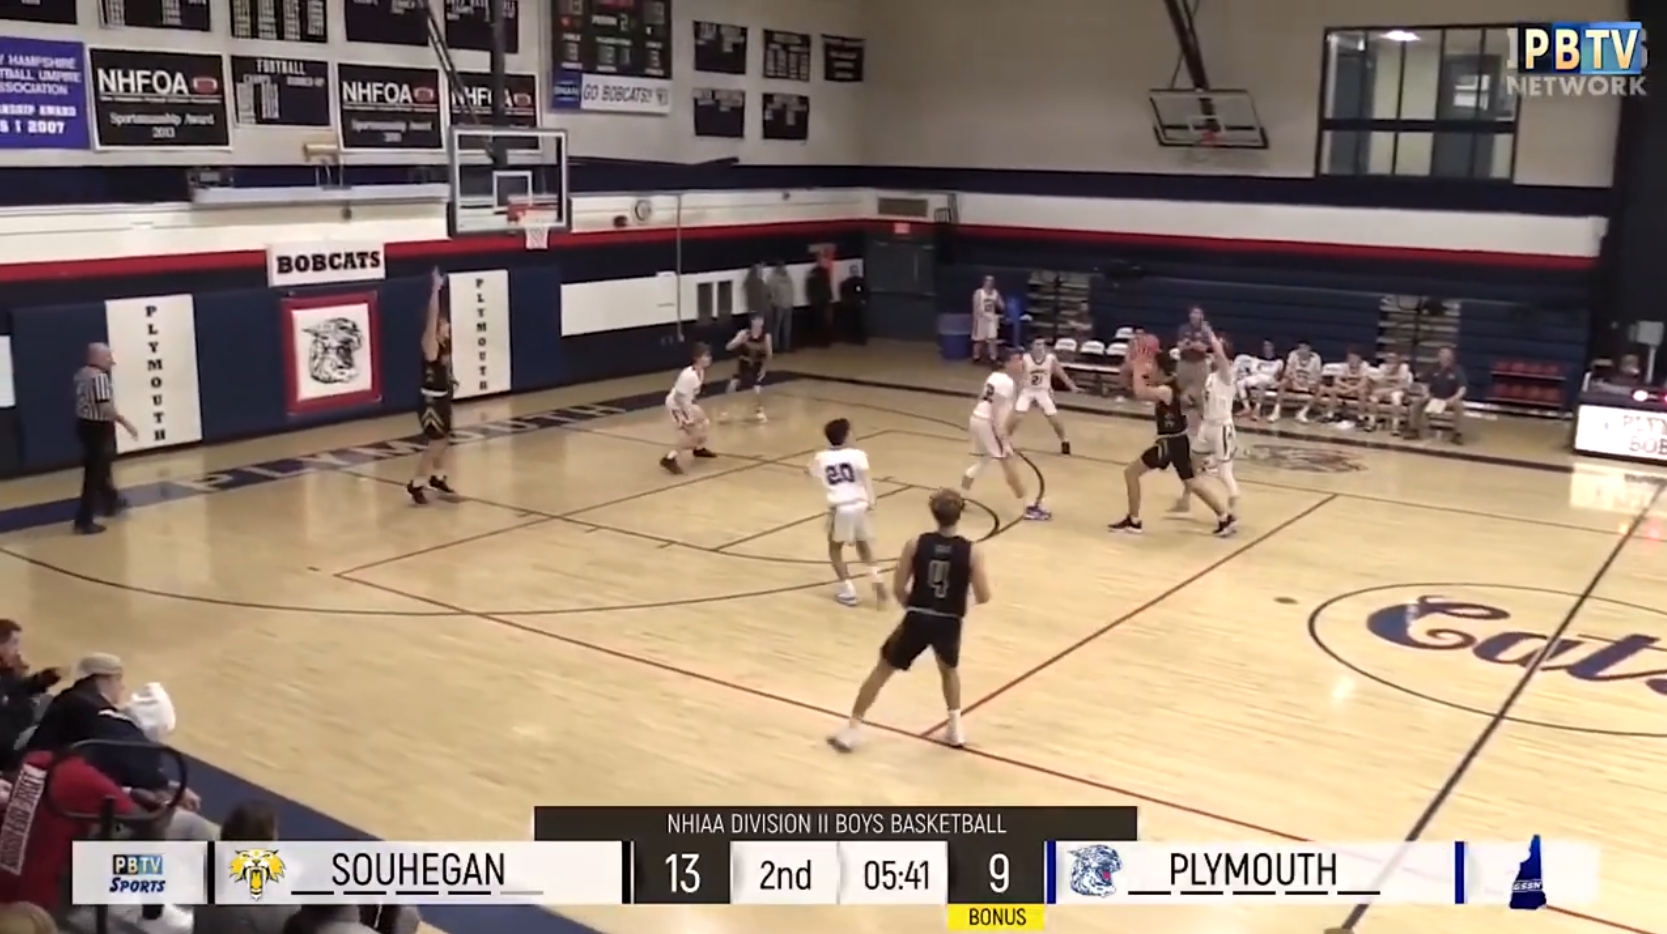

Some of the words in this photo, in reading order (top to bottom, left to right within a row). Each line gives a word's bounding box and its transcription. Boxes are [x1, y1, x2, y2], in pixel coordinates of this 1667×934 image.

[8, 54, 76, 69] HAMPSHIRE
[256, 58, 306, 75] FOOTBALL
[97, 68, 189, 95] NHFOA
[343, 82, 412, 103] NHFOA
[583, 85, 599, 99] GO
[452, 87, 513, 107] NHFA
[28, 120, 65, 134] 2007
[277, 251, 380, 274] BOBCATS
[475, 278, 487, 390] PLYMOUTH
[145, 305, 166, 441] PLYMOUTH
[825, 462, 856, 486] 20
[927, 559, 951, 599] 4
[1366, 594, 1667, 696] Cat
